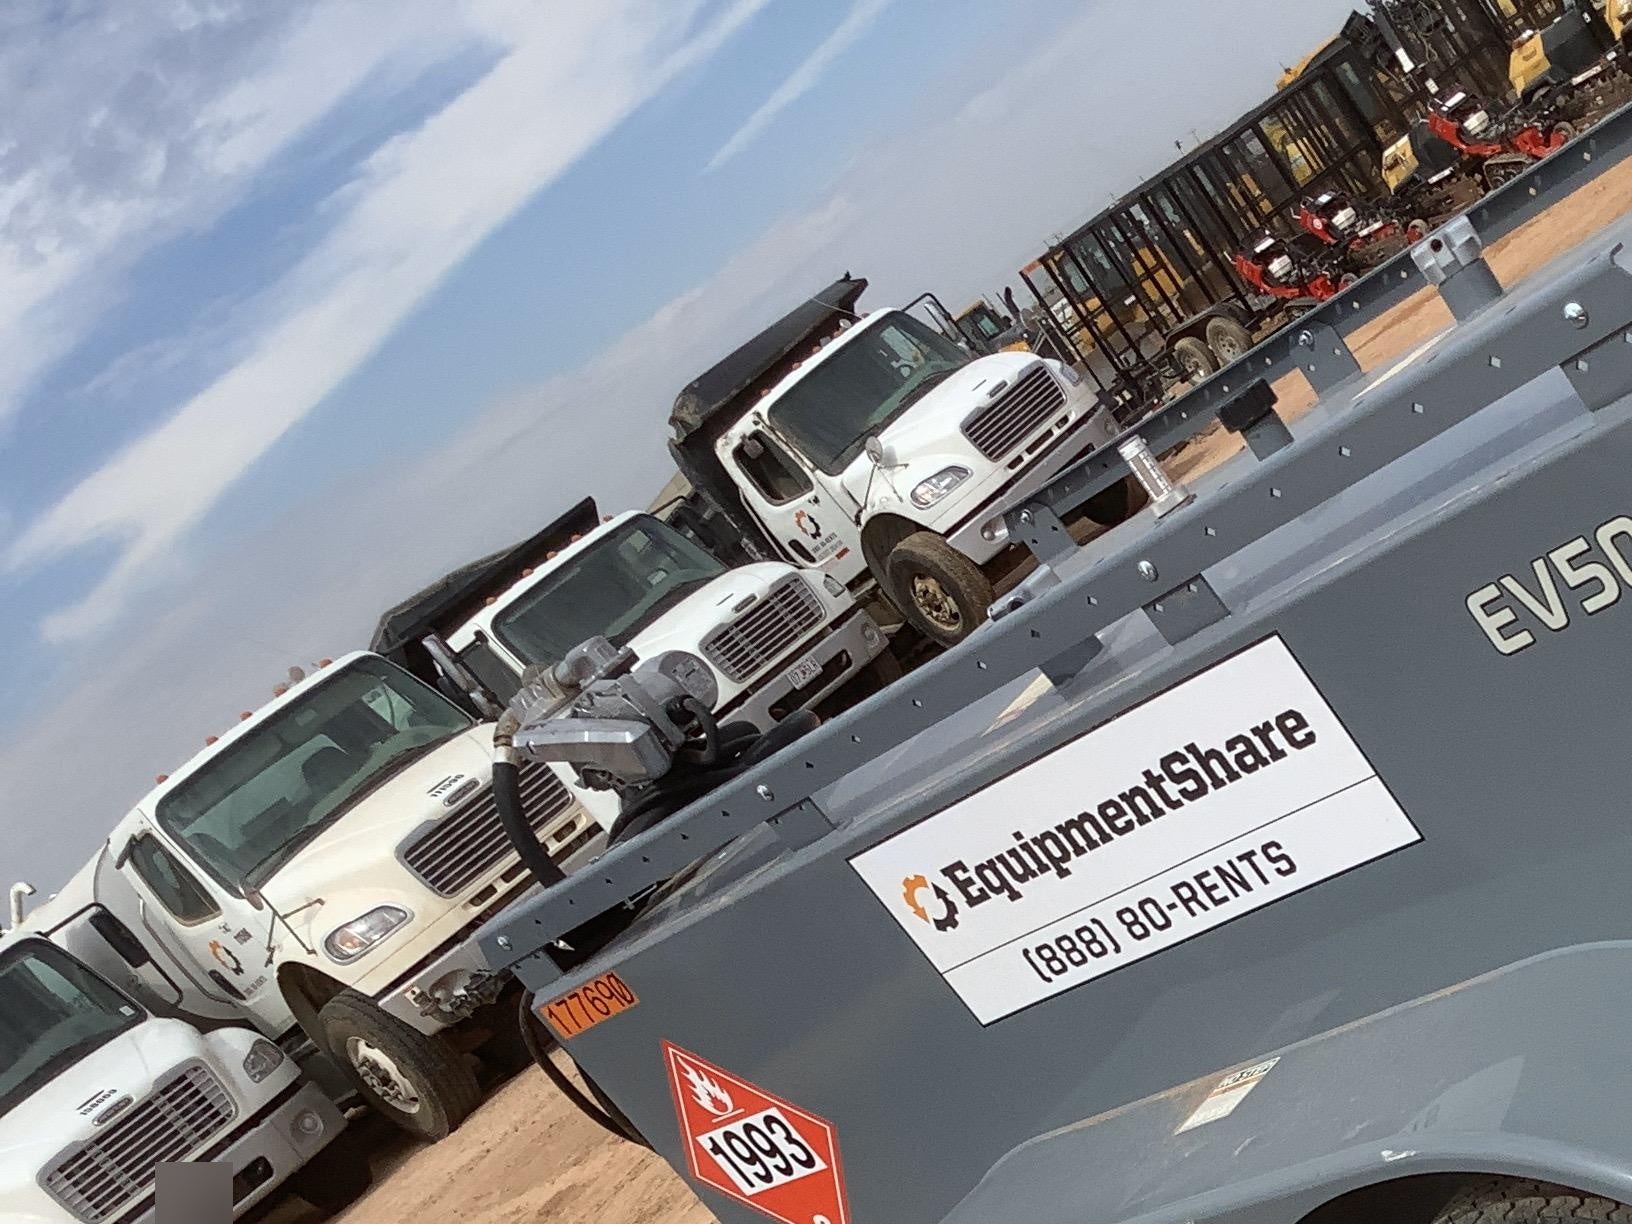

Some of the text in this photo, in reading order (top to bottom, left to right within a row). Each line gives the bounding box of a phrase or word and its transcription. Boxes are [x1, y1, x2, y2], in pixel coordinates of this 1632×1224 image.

[940, 708, 1317, 908] EquipmentShare
[1022, 840, 1297, 983] (888) 80-RENTS
[547, 972, 635, 1035] 177690
[708, 1113, 817, 1190] 1993
